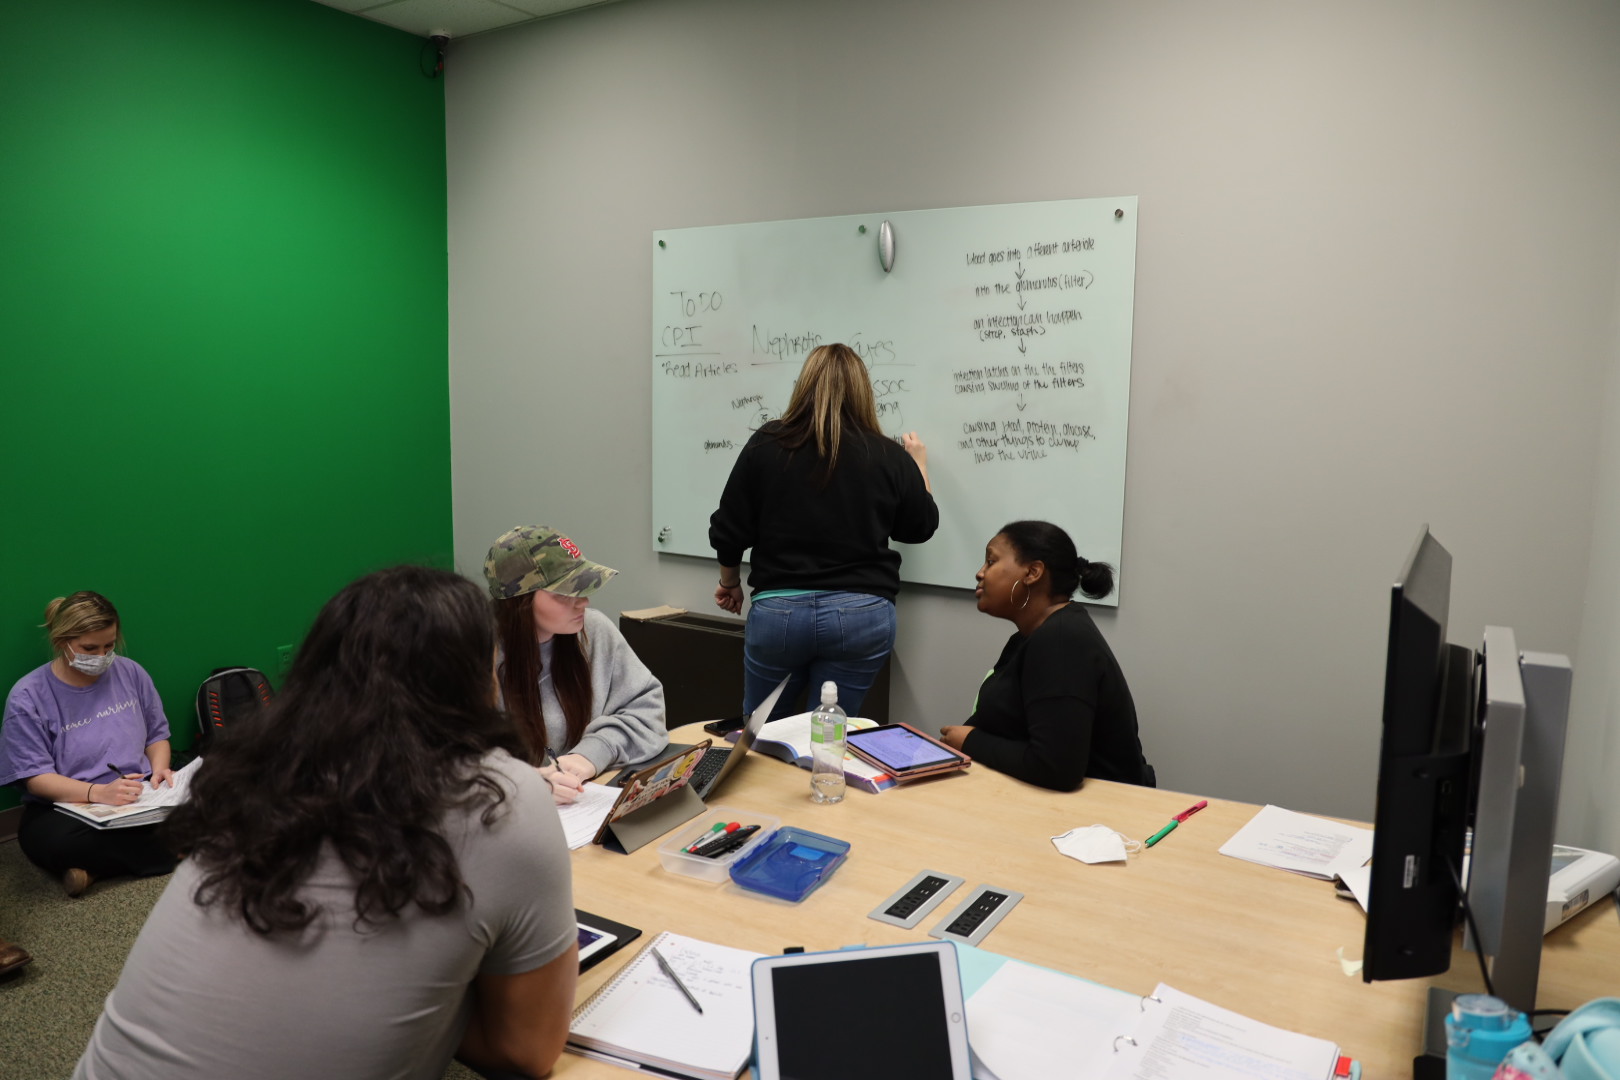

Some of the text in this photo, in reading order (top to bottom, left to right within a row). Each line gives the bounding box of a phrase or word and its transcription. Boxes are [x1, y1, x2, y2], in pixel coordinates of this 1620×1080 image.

[988, 250, 1005, 265] goes
[1006, 246, 1021, 262] into
[661, 325, 703, 348] CPI
[694, 361, 739, 378] Articles
[1059, 360, 1085, 376] filters
[1033, 378, 1049, 390] the
[1051, 376, 1085, 389] filters
[997, 448, 1016, 462] the
